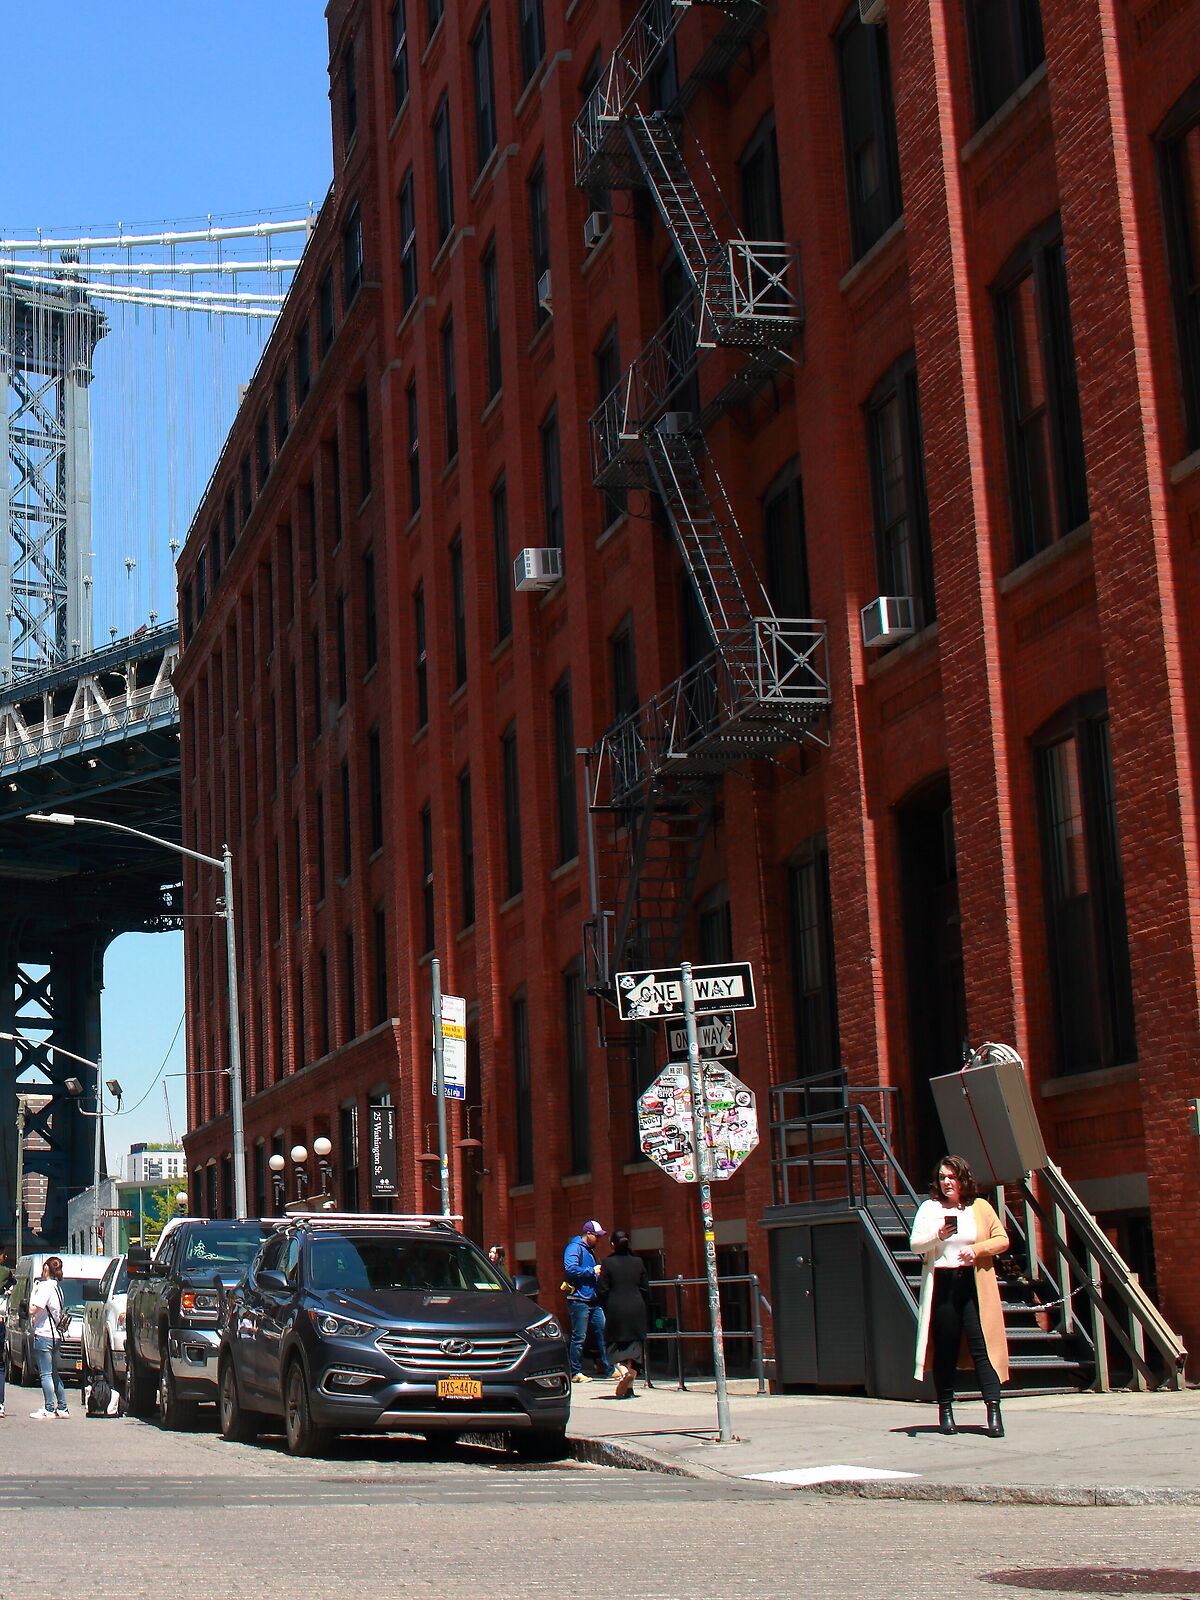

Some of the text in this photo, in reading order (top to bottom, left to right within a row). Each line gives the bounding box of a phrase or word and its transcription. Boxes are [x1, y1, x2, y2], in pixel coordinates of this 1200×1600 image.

[640, 983, 678, 1003] ONE
[695, 979, 735, 998] WAY
[675, 1026, 724, 1049] ON WAY
[373, 1111, 382, 1121] 25
[371, 1122, 382, 1165] Washington
[101, 1209, 125, 1217] Plymouth
